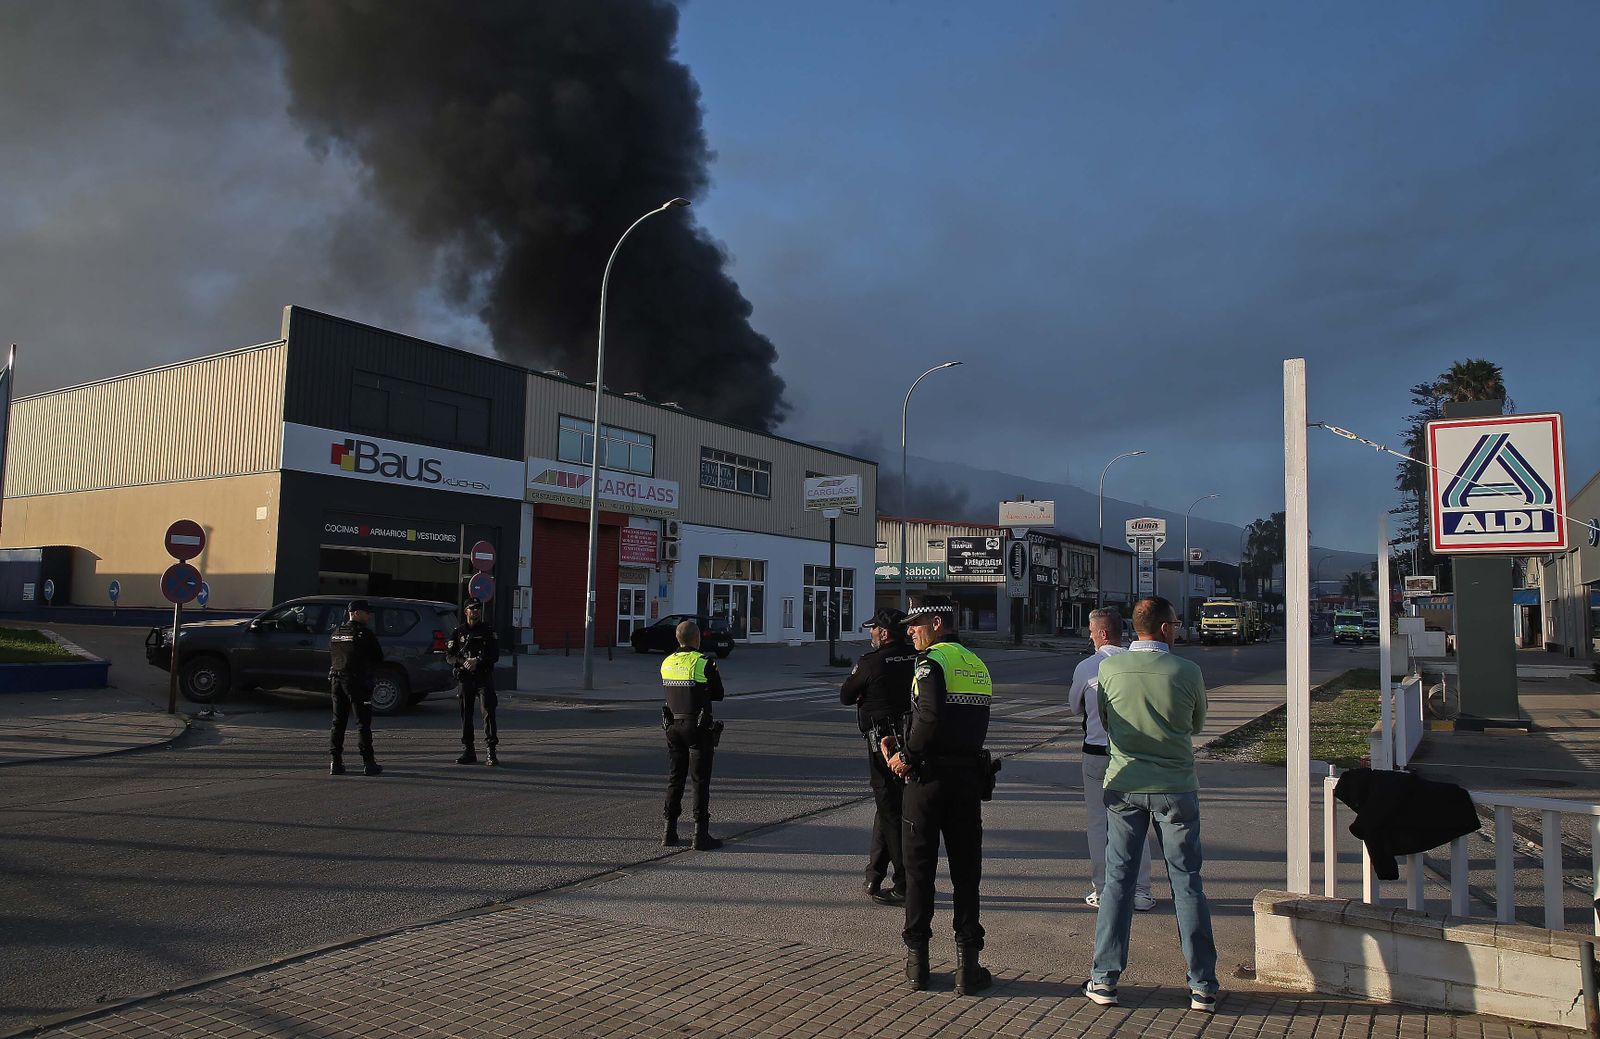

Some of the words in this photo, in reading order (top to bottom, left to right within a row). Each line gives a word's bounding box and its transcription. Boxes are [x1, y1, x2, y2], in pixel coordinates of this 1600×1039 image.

[354, 440, 442, 483] Baus
[808, 487, 856, 497] CARGLASS
[1454, 511, 1543, 533] ALDI
[325, 523, 359, 535] COCINAS
[370, 528, 407, 538] ARMARIOS
[417, 532, 456, 542] VESTIDORES
[885, 655, 916, 663] POLIC
